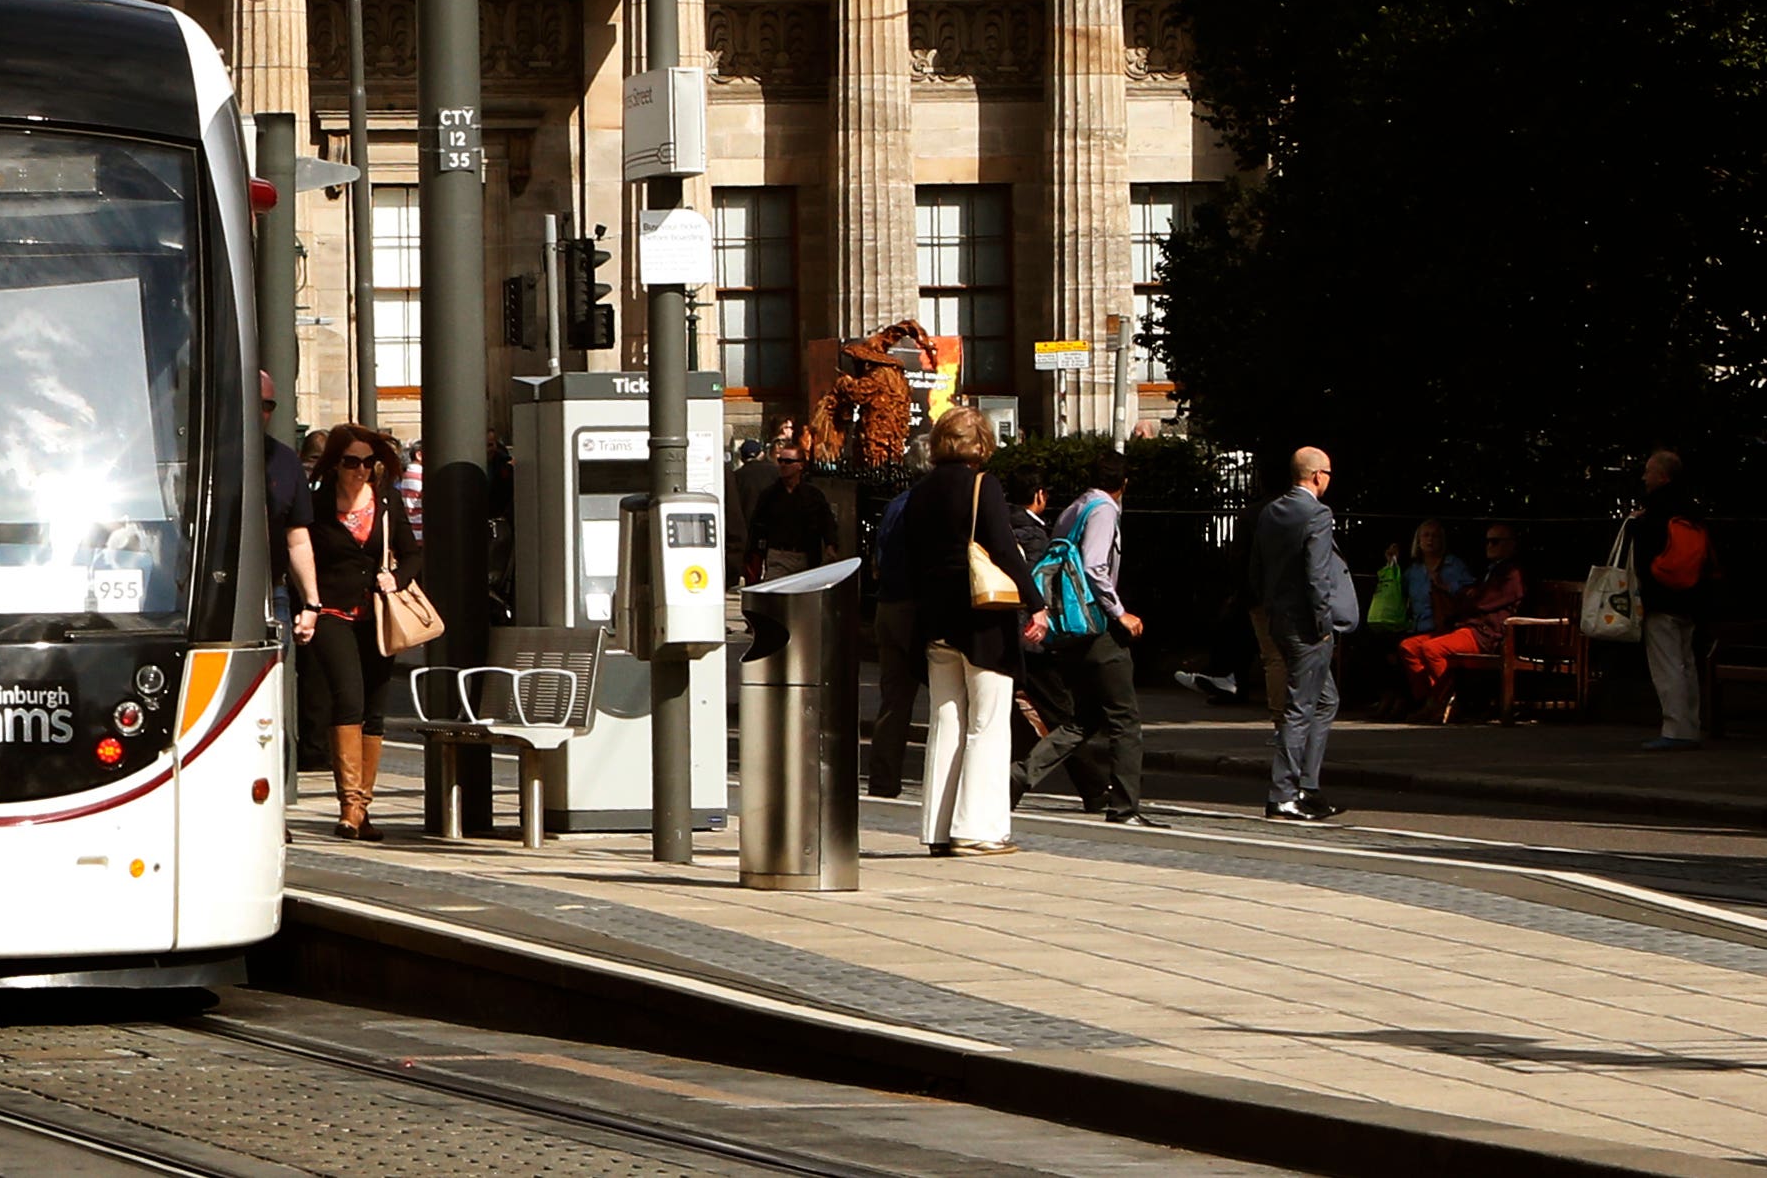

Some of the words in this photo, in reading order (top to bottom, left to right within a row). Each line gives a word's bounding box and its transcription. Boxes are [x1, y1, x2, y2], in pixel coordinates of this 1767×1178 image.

[440, 109, 474, 126] CTY
[450, 130, 466, 147] 12
[449, 152, 470, 168] 35
[612, 377, 650, 394] Tick
[599, 439, 633, 452] Trams
[98, 581, 139, 600] 955
